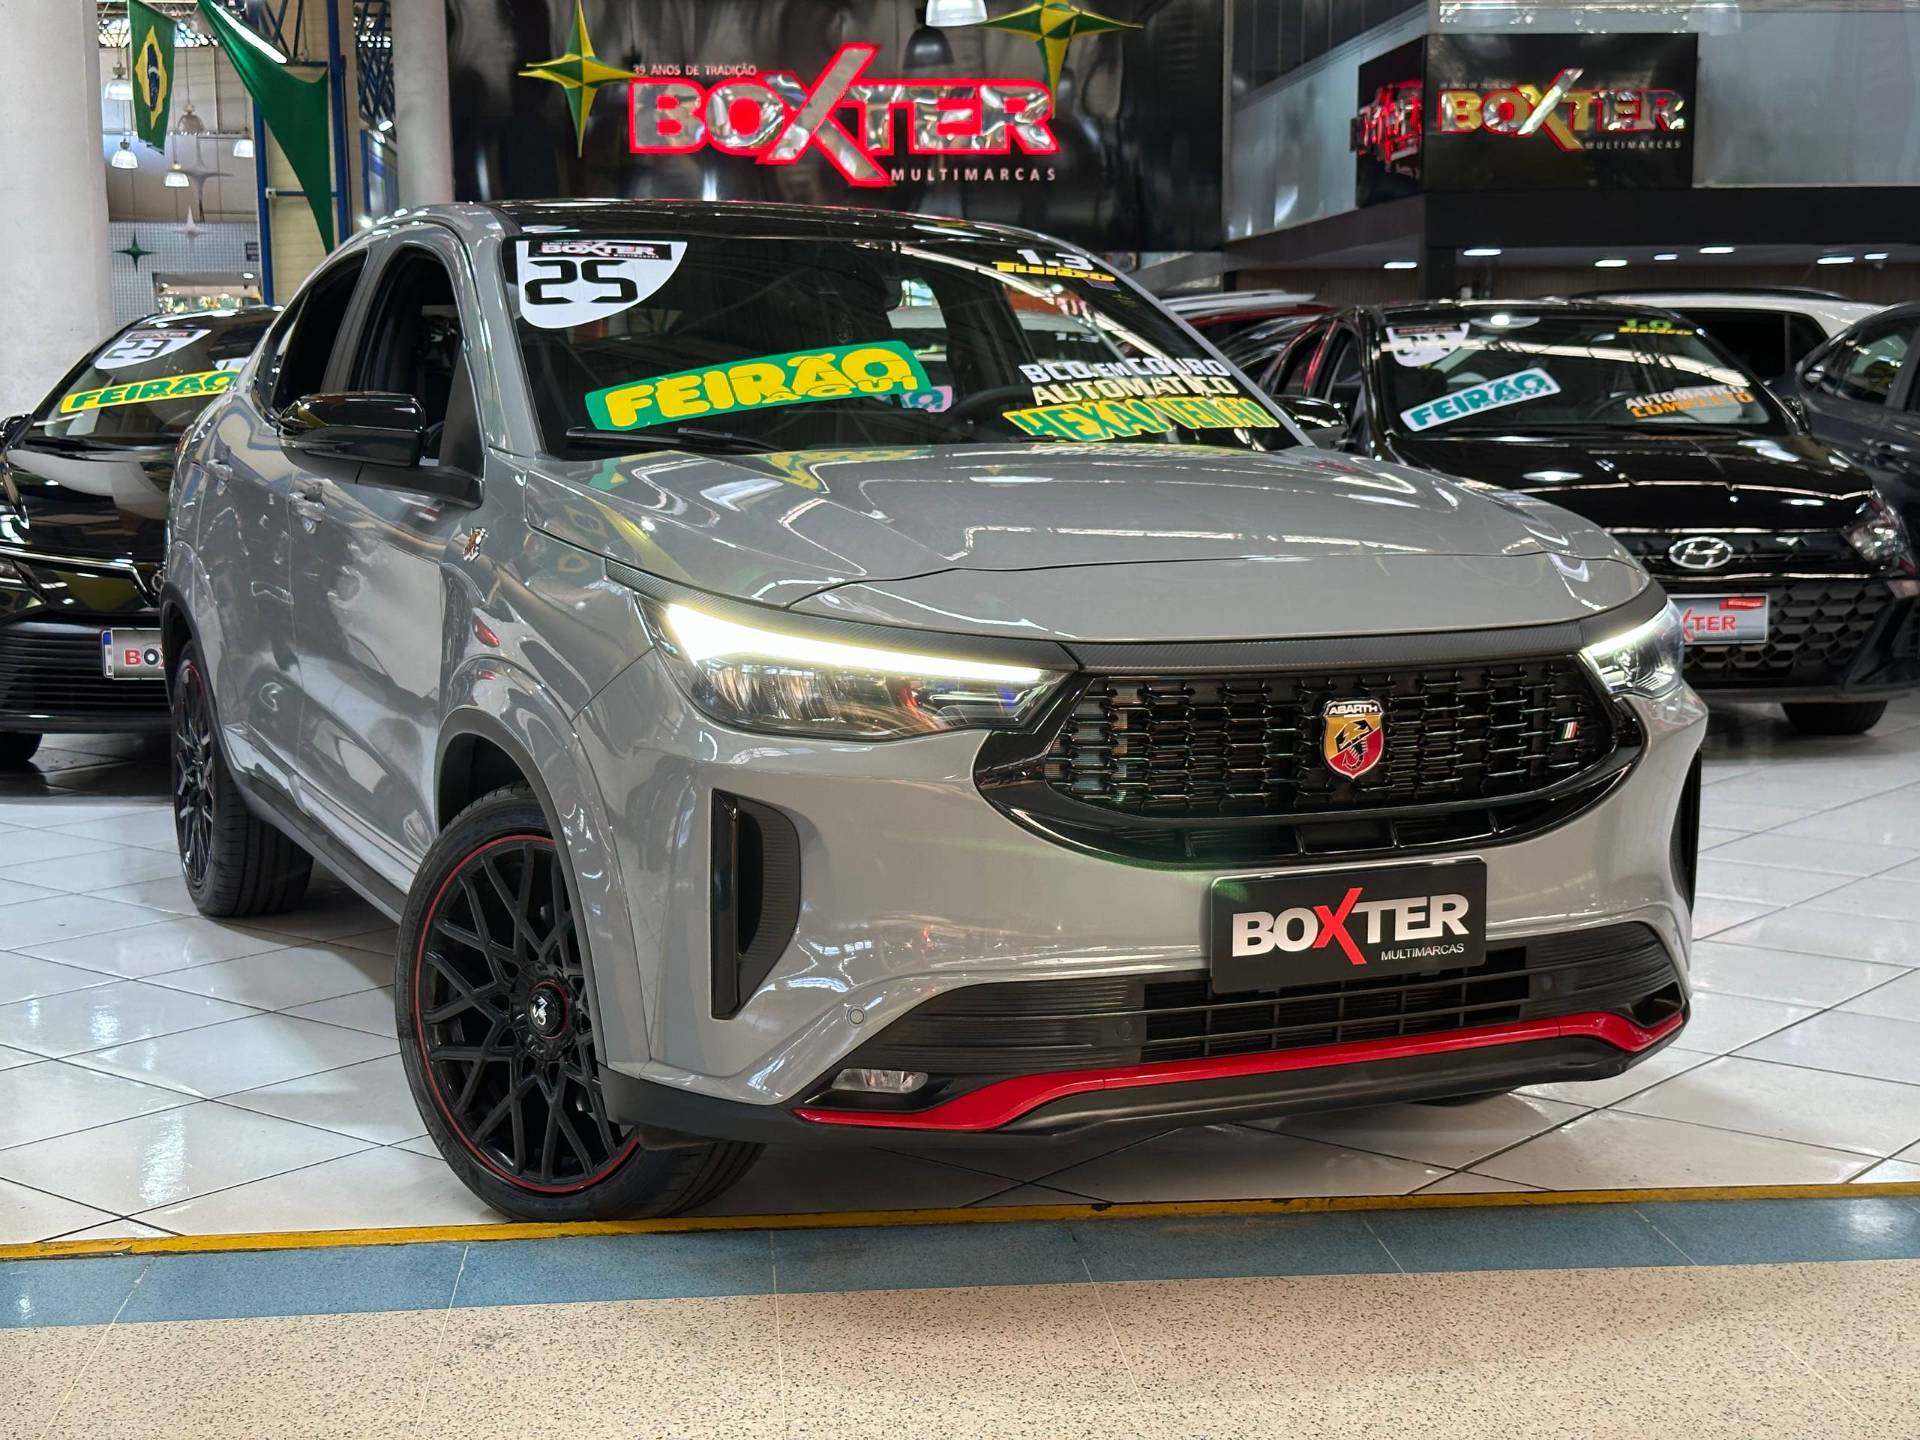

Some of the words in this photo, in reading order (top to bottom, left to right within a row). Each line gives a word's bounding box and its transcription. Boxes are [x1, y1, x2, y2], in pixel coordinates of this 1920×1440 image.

[650, 64, 681, 76] ANOS
[685, 65, 700, 76] DE
[704, 62, 757, 77] TRADIÇÃO
[628, 42, 1062, 188] BOXTER
[1436, 67, 1687, 152] BOXTER
[891, 168, 1057, 182] MULTIMARCAS
[1017, 249, 1094, 271] 1.3
[524, 259, 639, 305] 25
[1125, 357, 1232, 377] COURO
[604, 347, 913, 427] FEIRÃO
[1410, 373, 1546, 427] FEIRÃO
[1328, 704, 1379, 715] ABARTH
[1232, 887, 1470, 966] BOXTER
[1381, 942, 1465, 961] MULTIMARCAS
